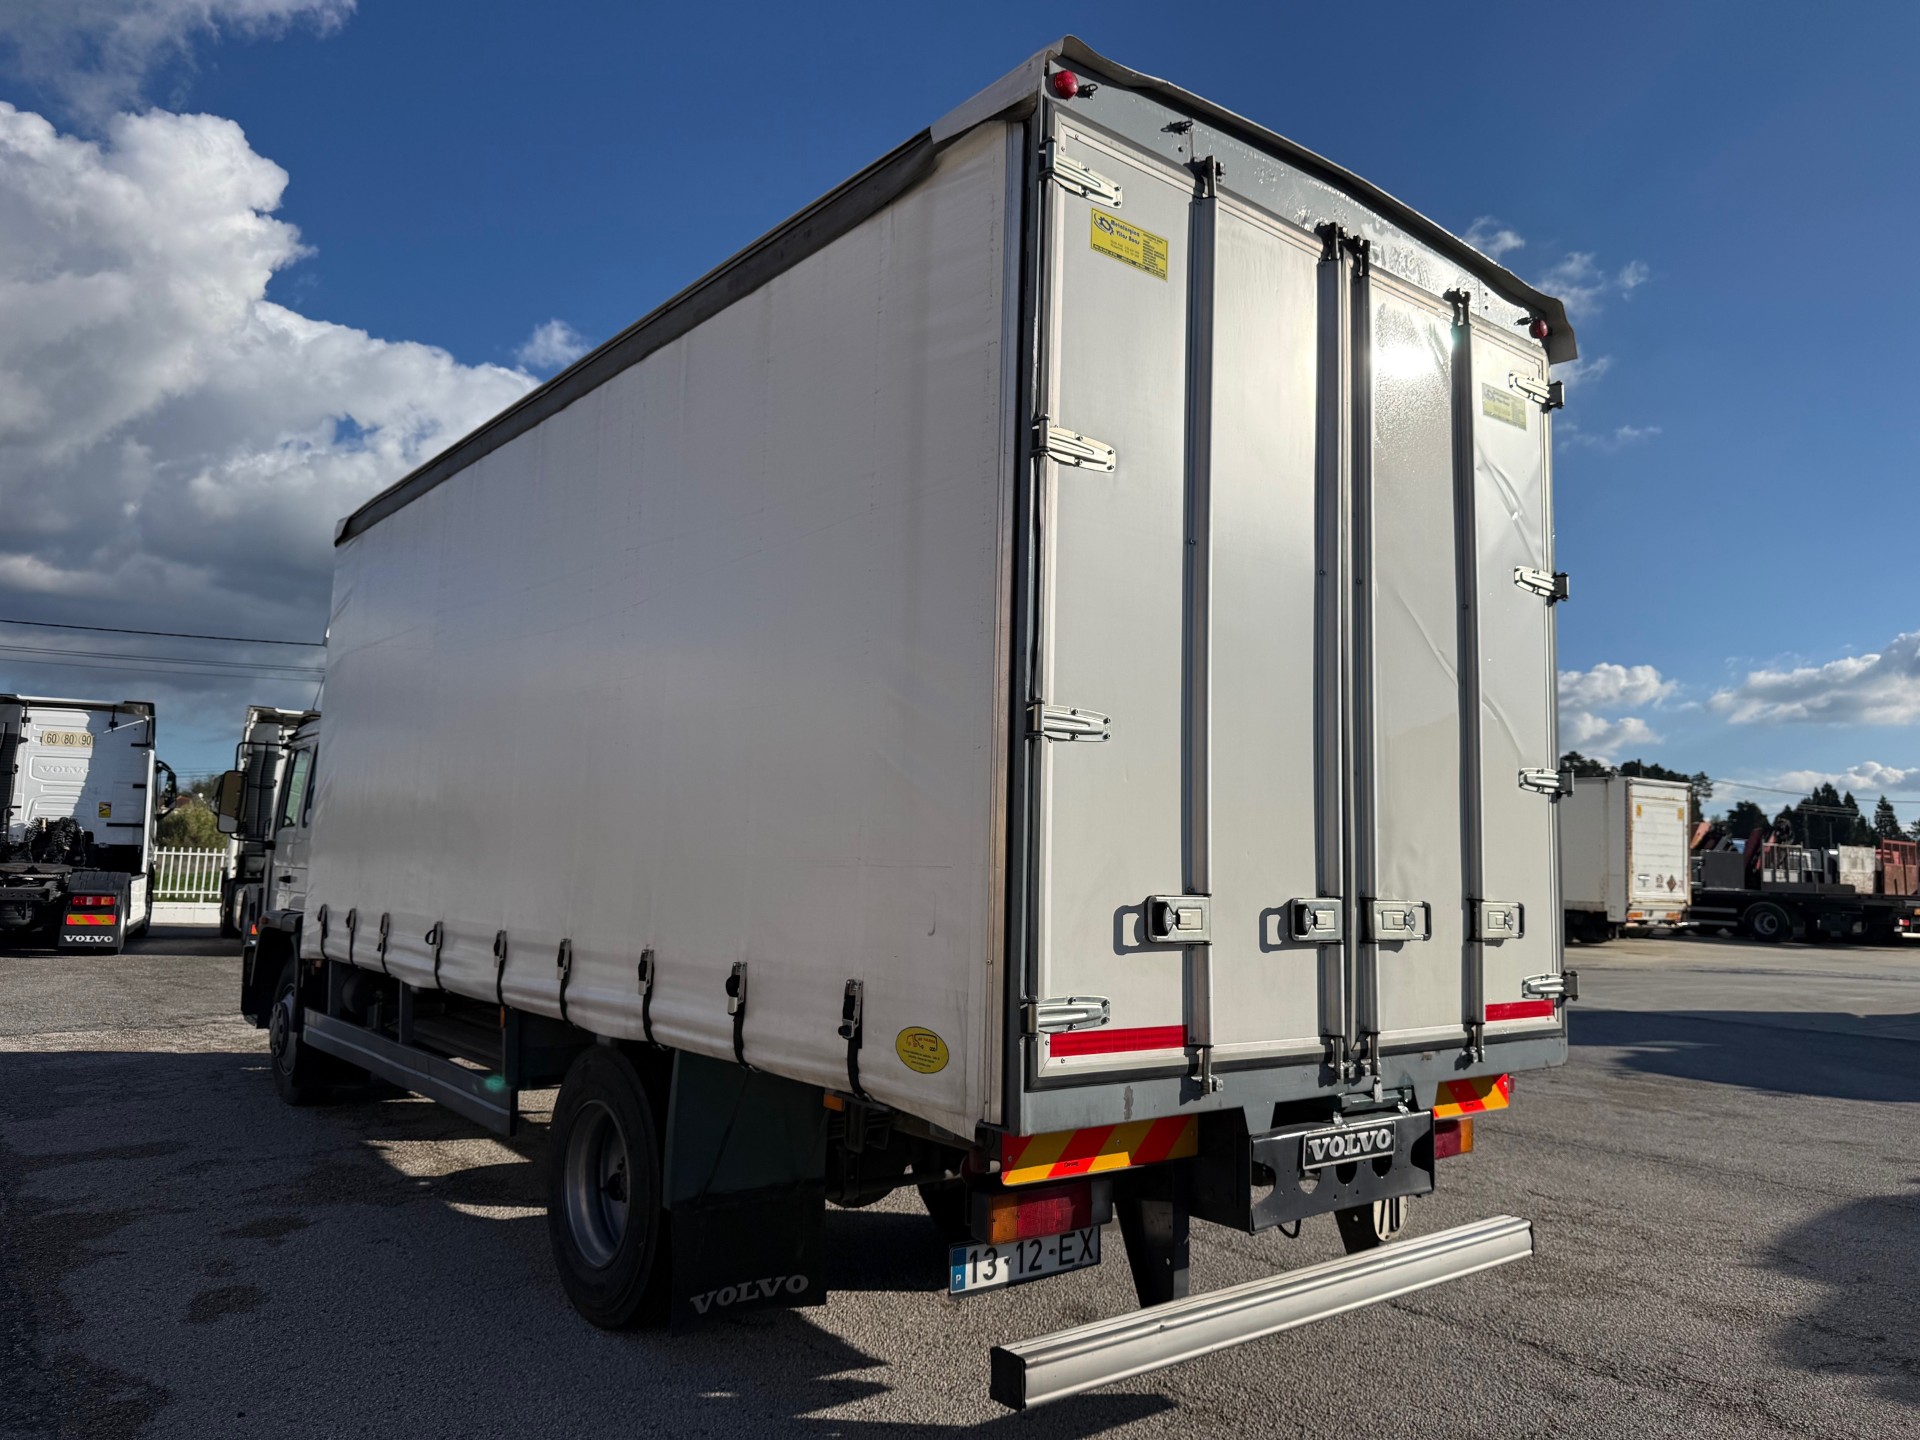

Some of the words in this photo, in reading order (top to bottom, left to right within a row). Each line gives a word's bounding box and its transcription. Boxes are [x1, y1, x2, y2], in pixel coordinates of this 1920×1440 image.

[46, 733, 57, 744] 60
[64, 734, 75, 745] 80
[81, 735, 92, 746] 90
[63, 935, 114, 943] VOLVO
[1308, 1128, 1392, 1161] VOLVO
[689, 1274, 809, 1315] VOLVO
